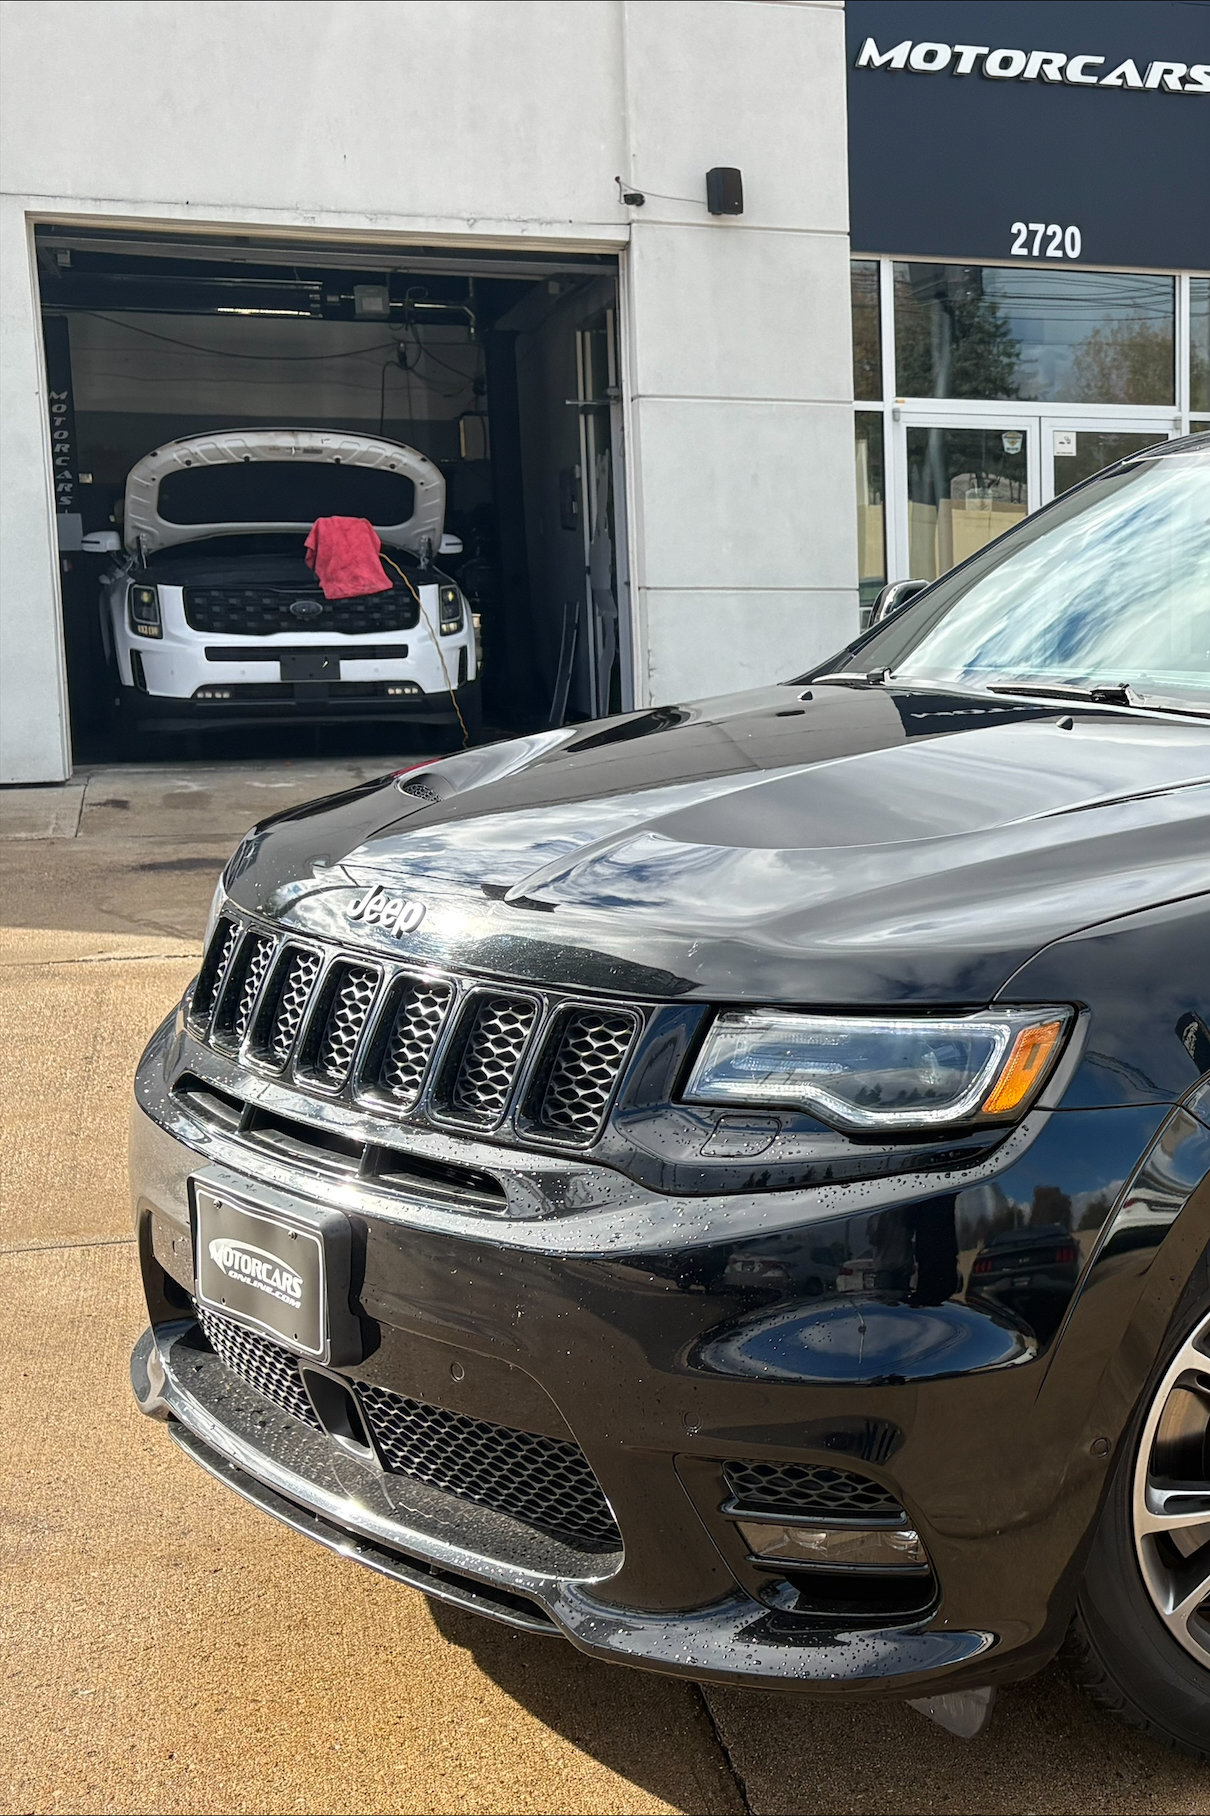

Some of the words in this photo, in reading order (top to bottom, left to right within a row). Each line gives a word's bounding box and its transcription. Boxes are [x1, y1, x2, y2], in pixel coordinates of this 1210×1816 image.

[1010, 222, 1082, 259] 2720
[50, 390, 73, 506] MOTORCARS
[346, 884, 427, 939] Jeep
[209, 1241, 304, 1299] MOTORCARS
[227, 1269, 302, 1309] ONLINE.COM
